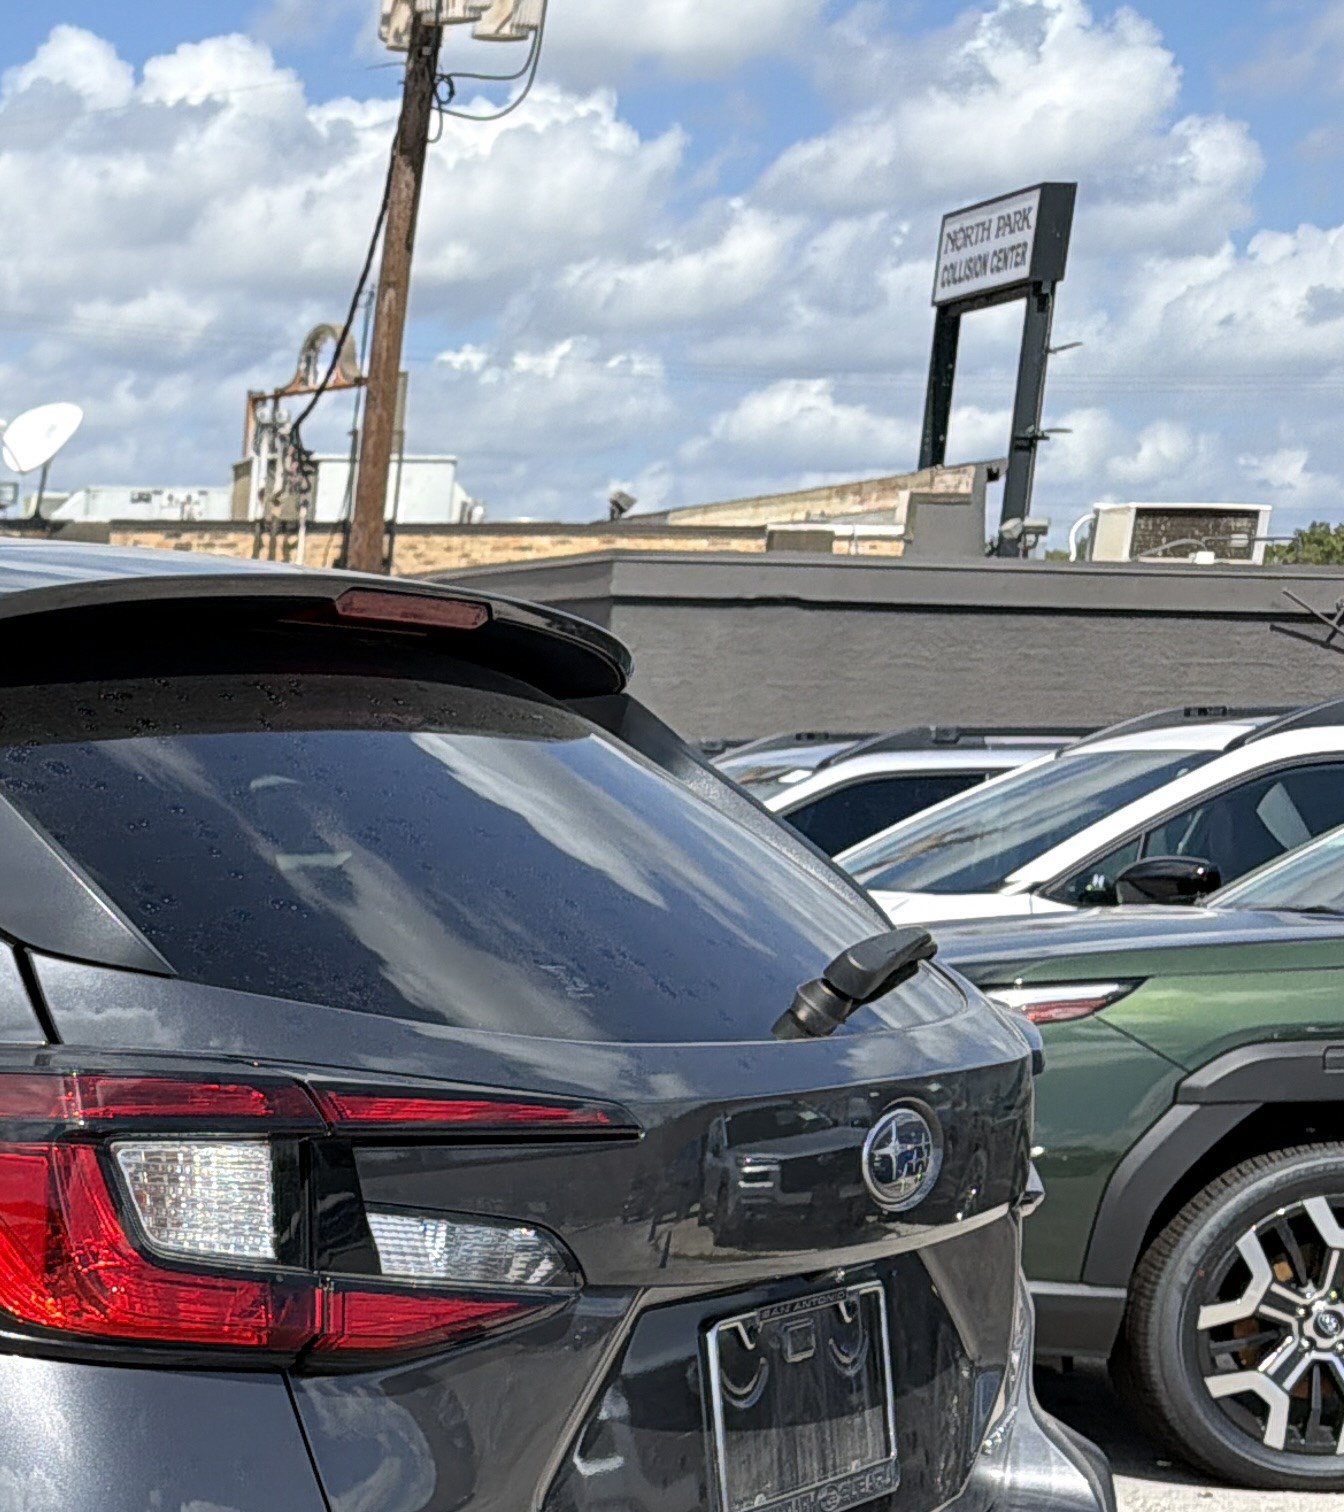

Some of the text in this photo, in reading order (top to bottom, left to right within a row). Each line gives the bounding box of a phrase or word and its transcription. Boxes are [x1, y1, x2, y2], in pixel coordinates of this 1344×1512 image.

[943, 206, 1034, 255] NORTH PARK
[940, 241, 1029, 288] COLLISION CENTER
[792, 1291, 847, 1313] ANTONIO
